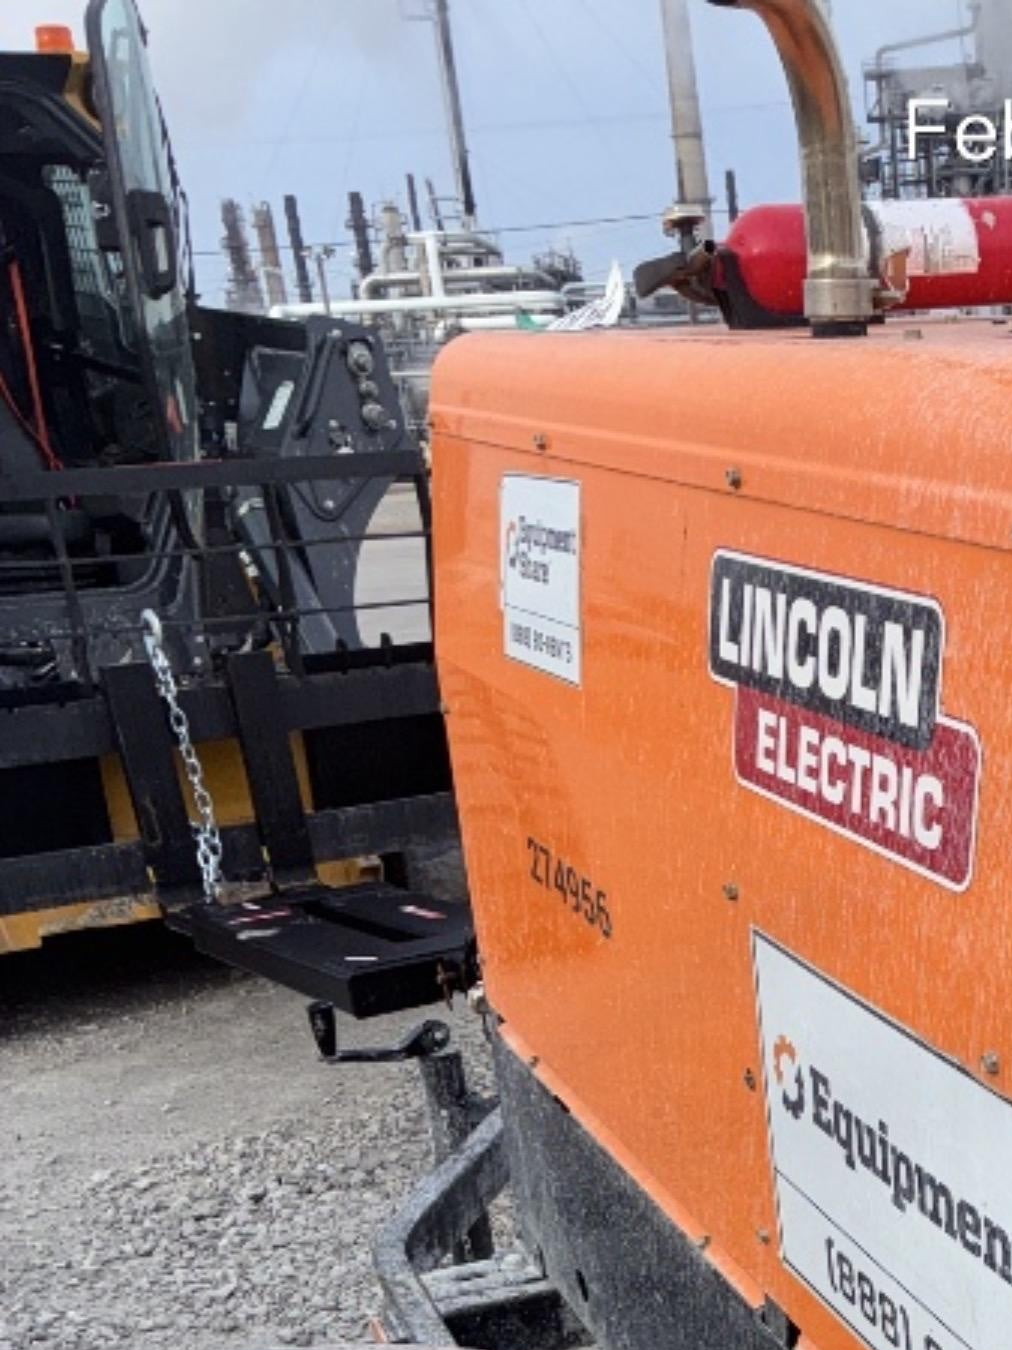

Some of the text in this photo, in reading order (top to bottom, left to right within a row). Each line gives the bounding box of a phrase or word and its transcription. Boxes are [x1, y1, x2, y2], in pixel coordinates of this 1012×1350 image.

[718, 577, 926, 728] LINCOLN
[756, 707, 944, 851] ELECTRIC
[527, 836, 613, 940] 274956
